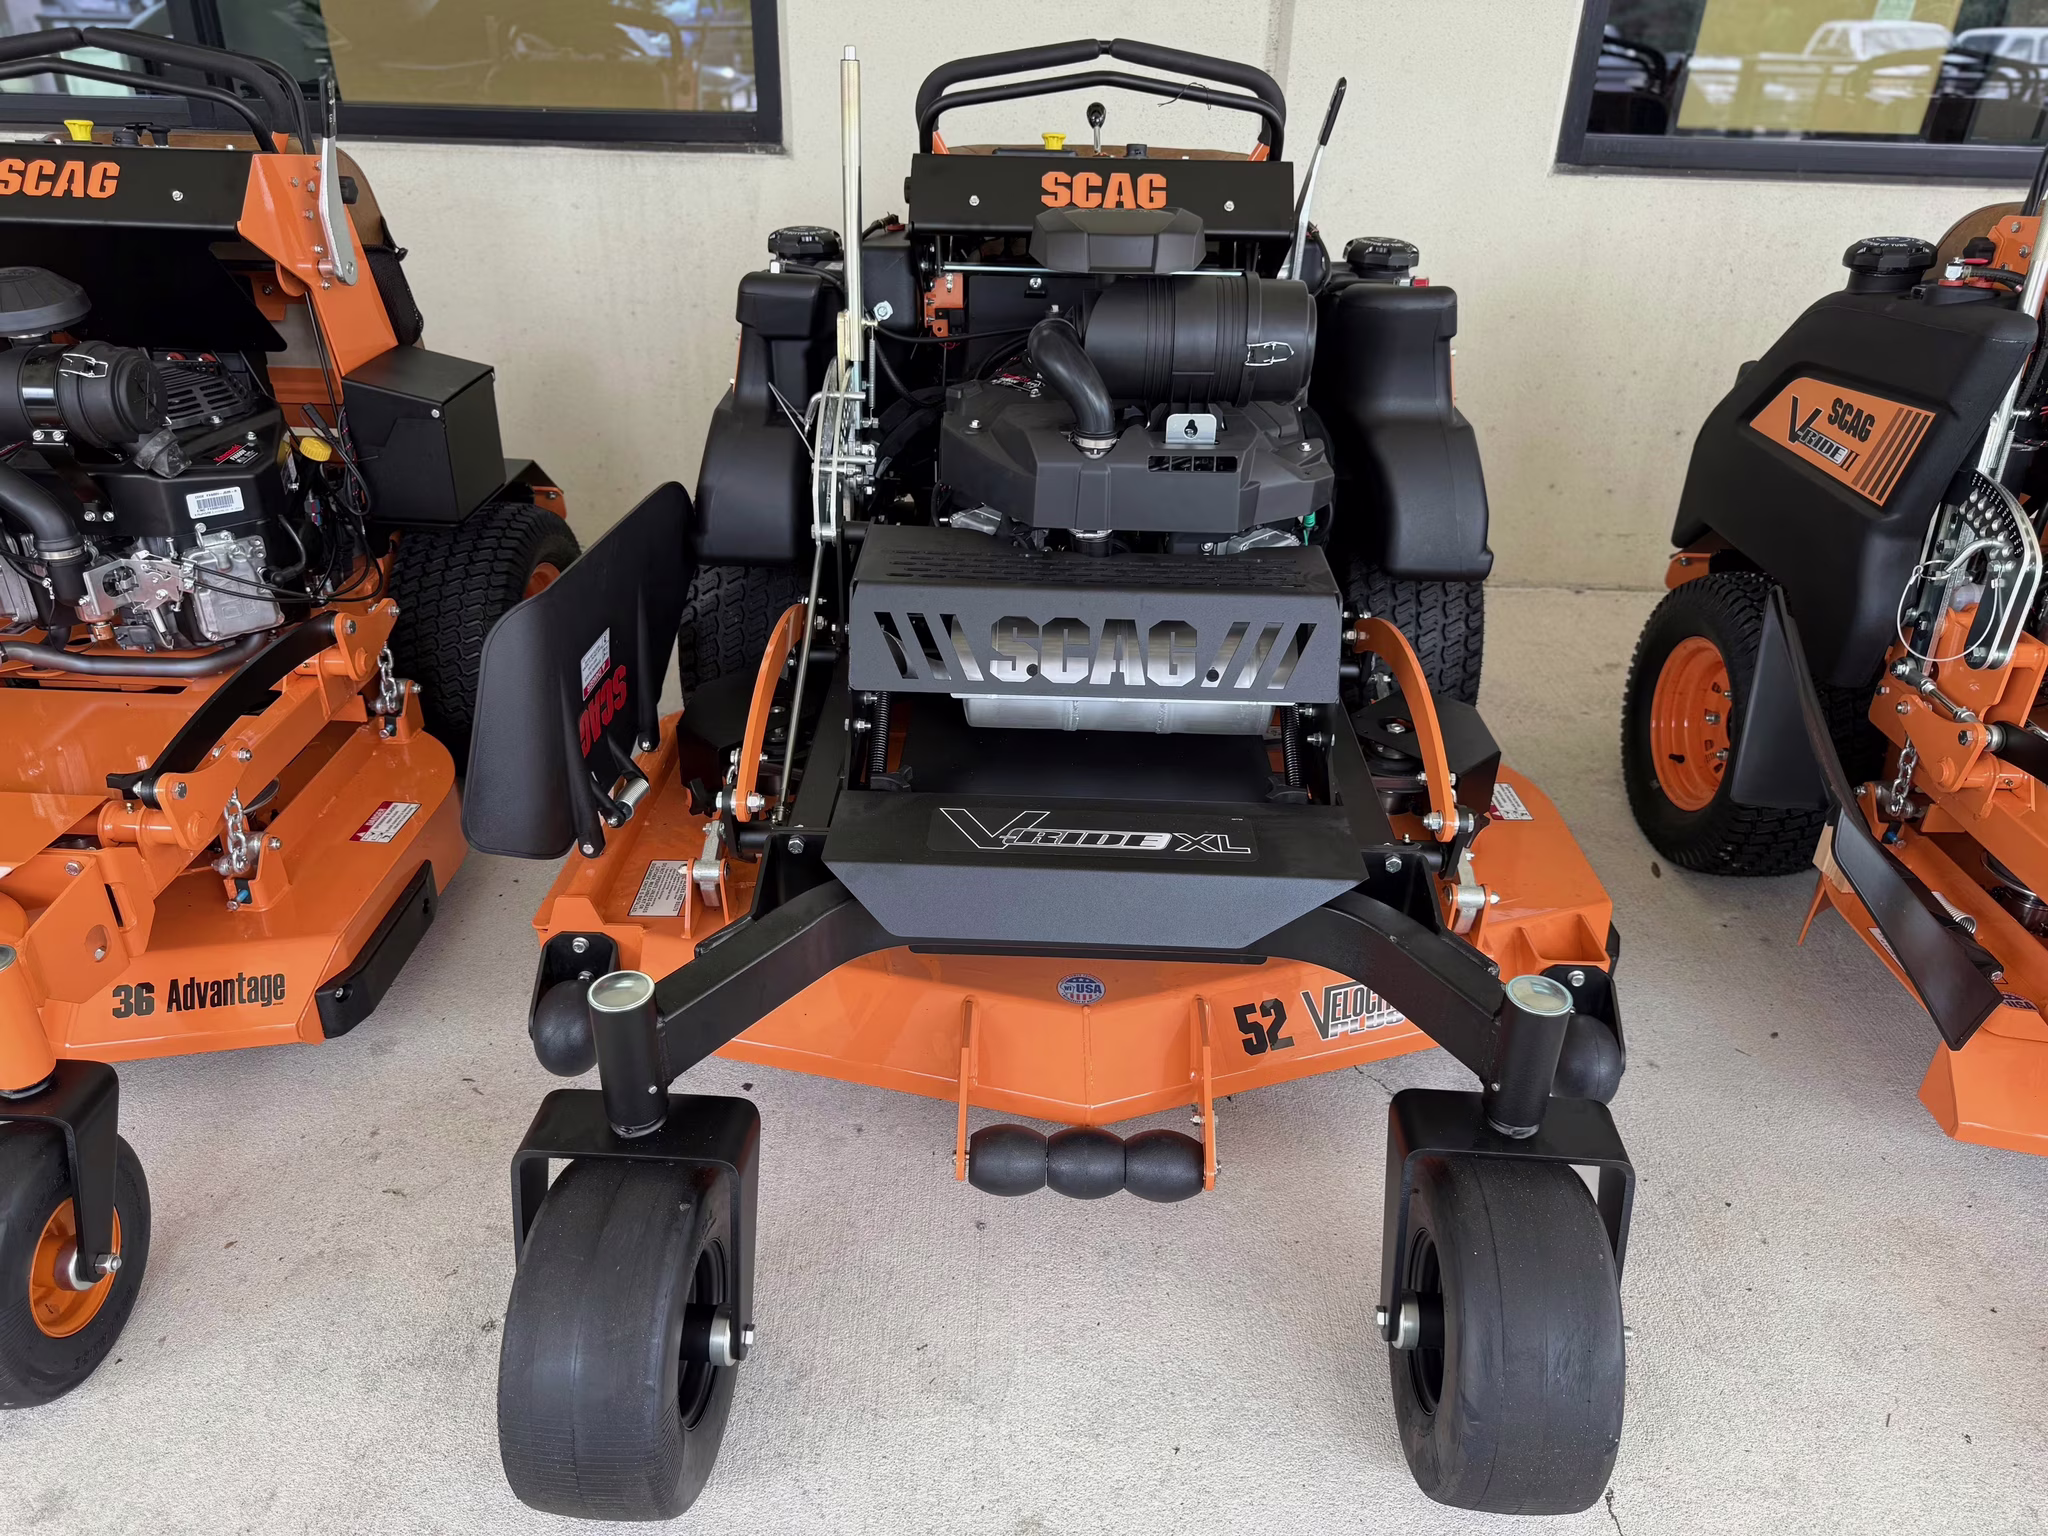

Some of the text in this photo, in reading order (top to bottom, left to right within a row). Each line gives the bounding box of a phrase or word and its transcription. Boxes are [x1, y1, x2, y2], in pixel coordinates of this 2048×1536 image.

[0, 158, 121, 199] SCAG
[1040, 171, 1167, 210] SCAG
[1827, 397, 1876, 443] SCAG
[989, 615, 1198, 687] SCAG
[579, 664, 627, 759] SCAG
[1173, 831, 1252, 854] XL
[112, 972, 286, 1019] 36 Advantage
[1076, 983, 1102, 994] USA
[1233, 998, 1295, 1056] 52
[1329, 1010, 1405, 1038] PLUS
